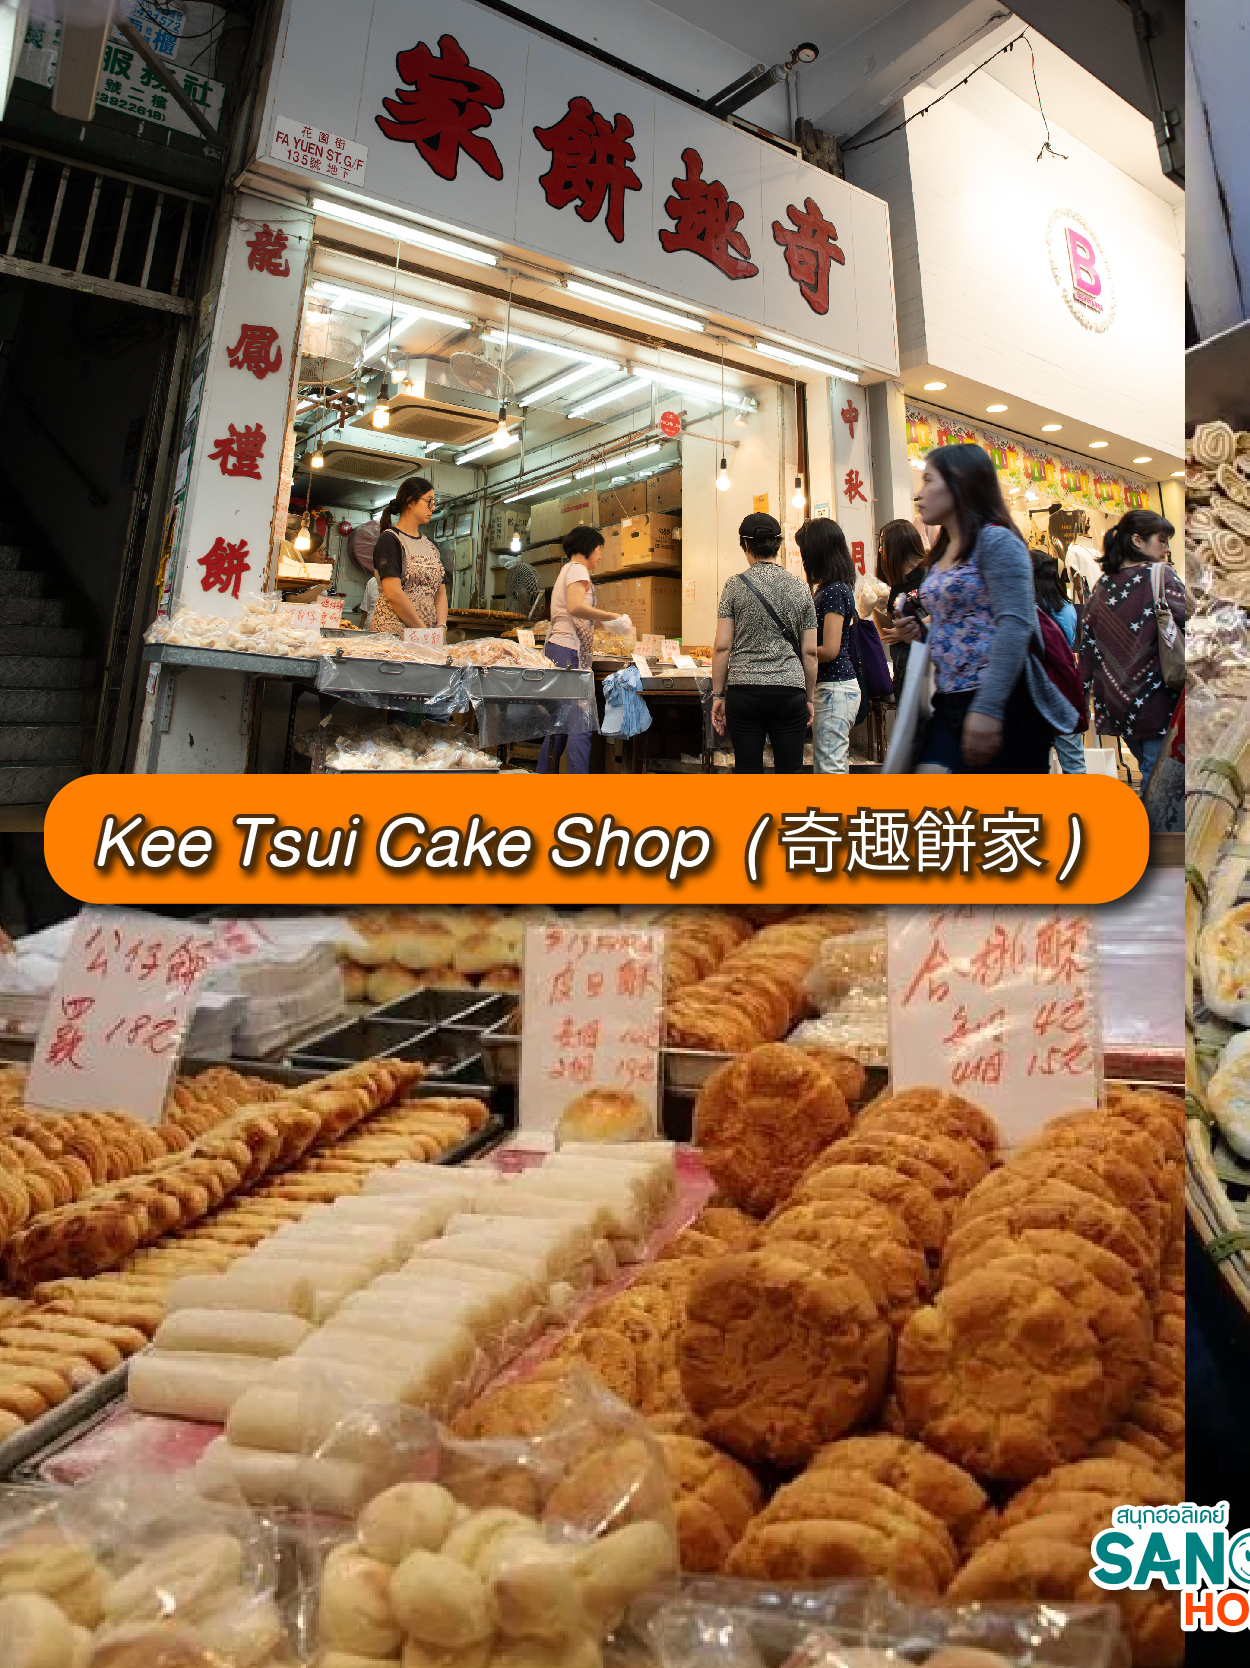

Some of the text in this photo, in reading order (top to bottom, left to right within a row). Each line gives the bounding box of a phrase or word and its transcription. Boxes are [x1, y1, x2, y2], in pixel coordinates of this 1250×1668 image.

[275, 130, 290, 147] FA
[293, 136, 324, 158] YUEN
[301, 126, 346, 151] 花園街
[1064, 226, 1102, 297] B
